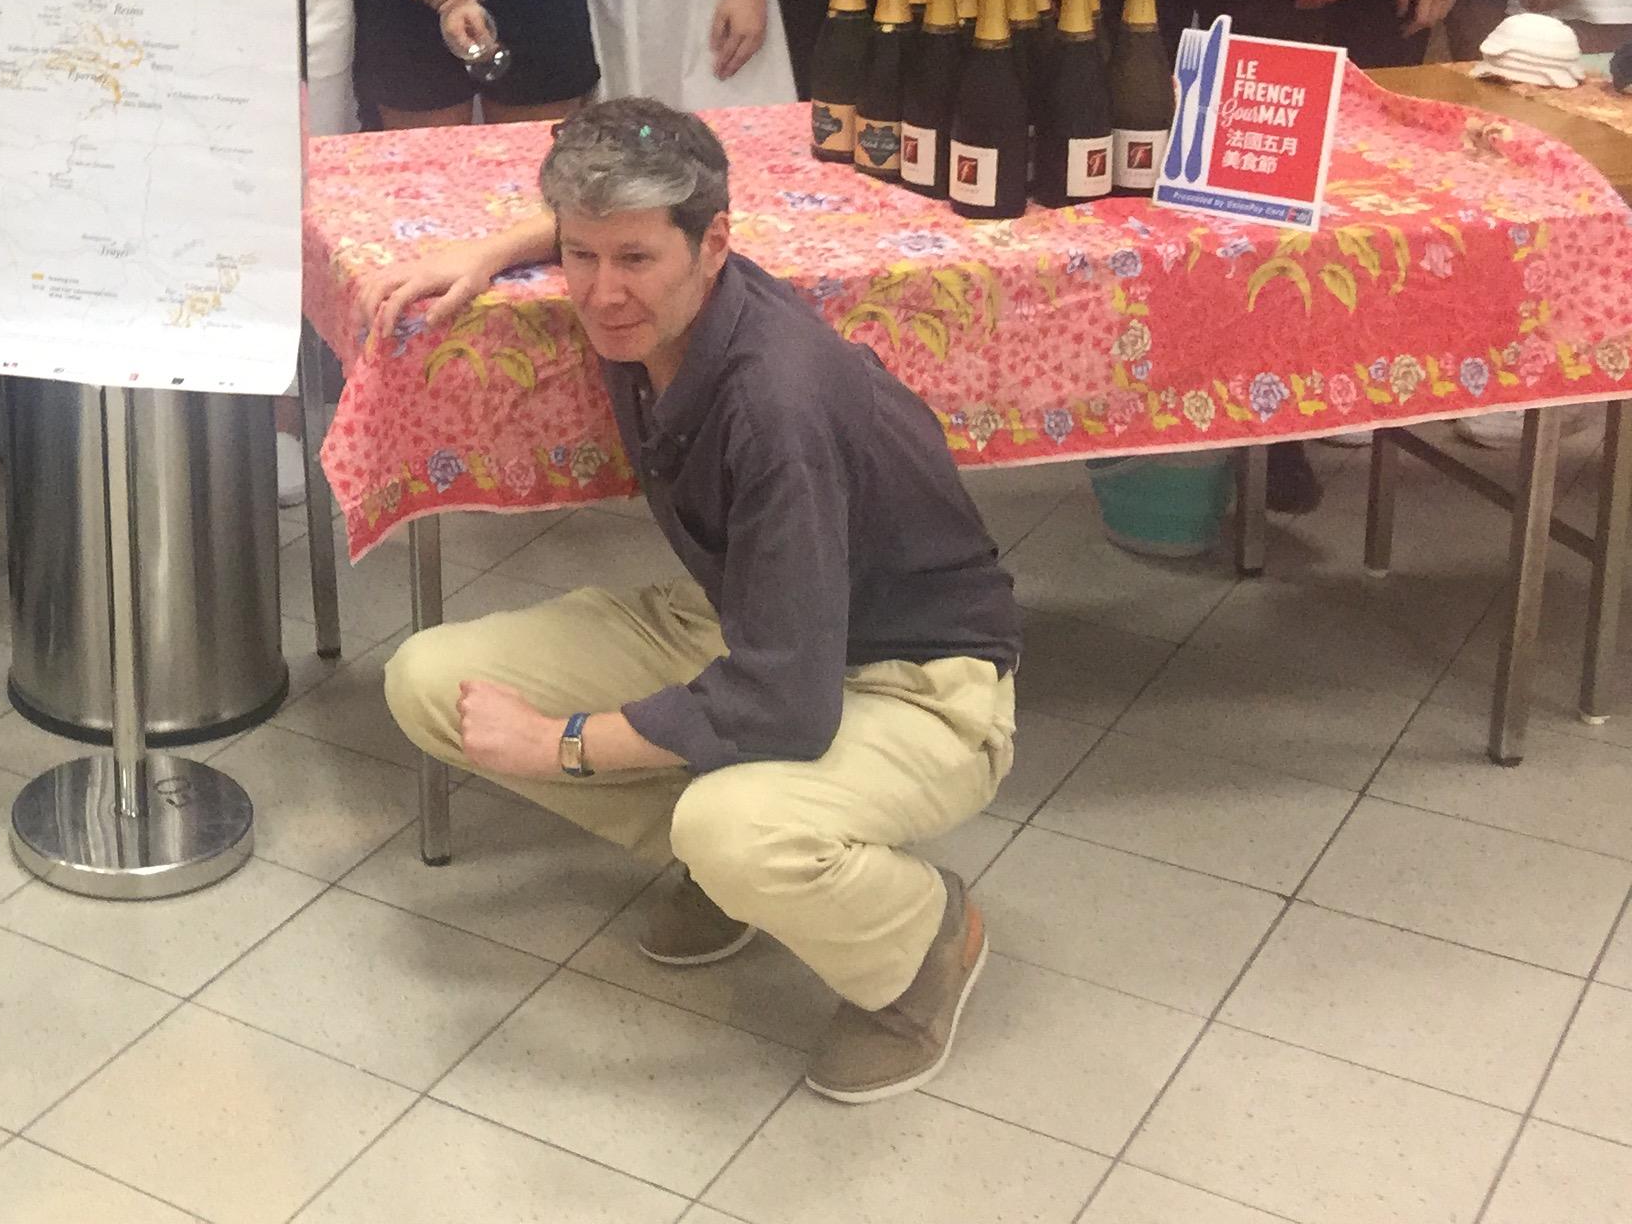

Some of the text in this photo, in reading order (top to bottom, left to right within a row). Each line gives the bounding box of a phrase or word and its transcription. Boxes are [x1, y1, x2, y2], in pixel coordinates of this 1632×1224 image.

[1236, 59, 1259, 80] LE
[1233, 80, 1305, 107] FRENCH
[1225, 128, 1298, 156] 法國五月
[1222, 150, 1279, 174] 美食節
